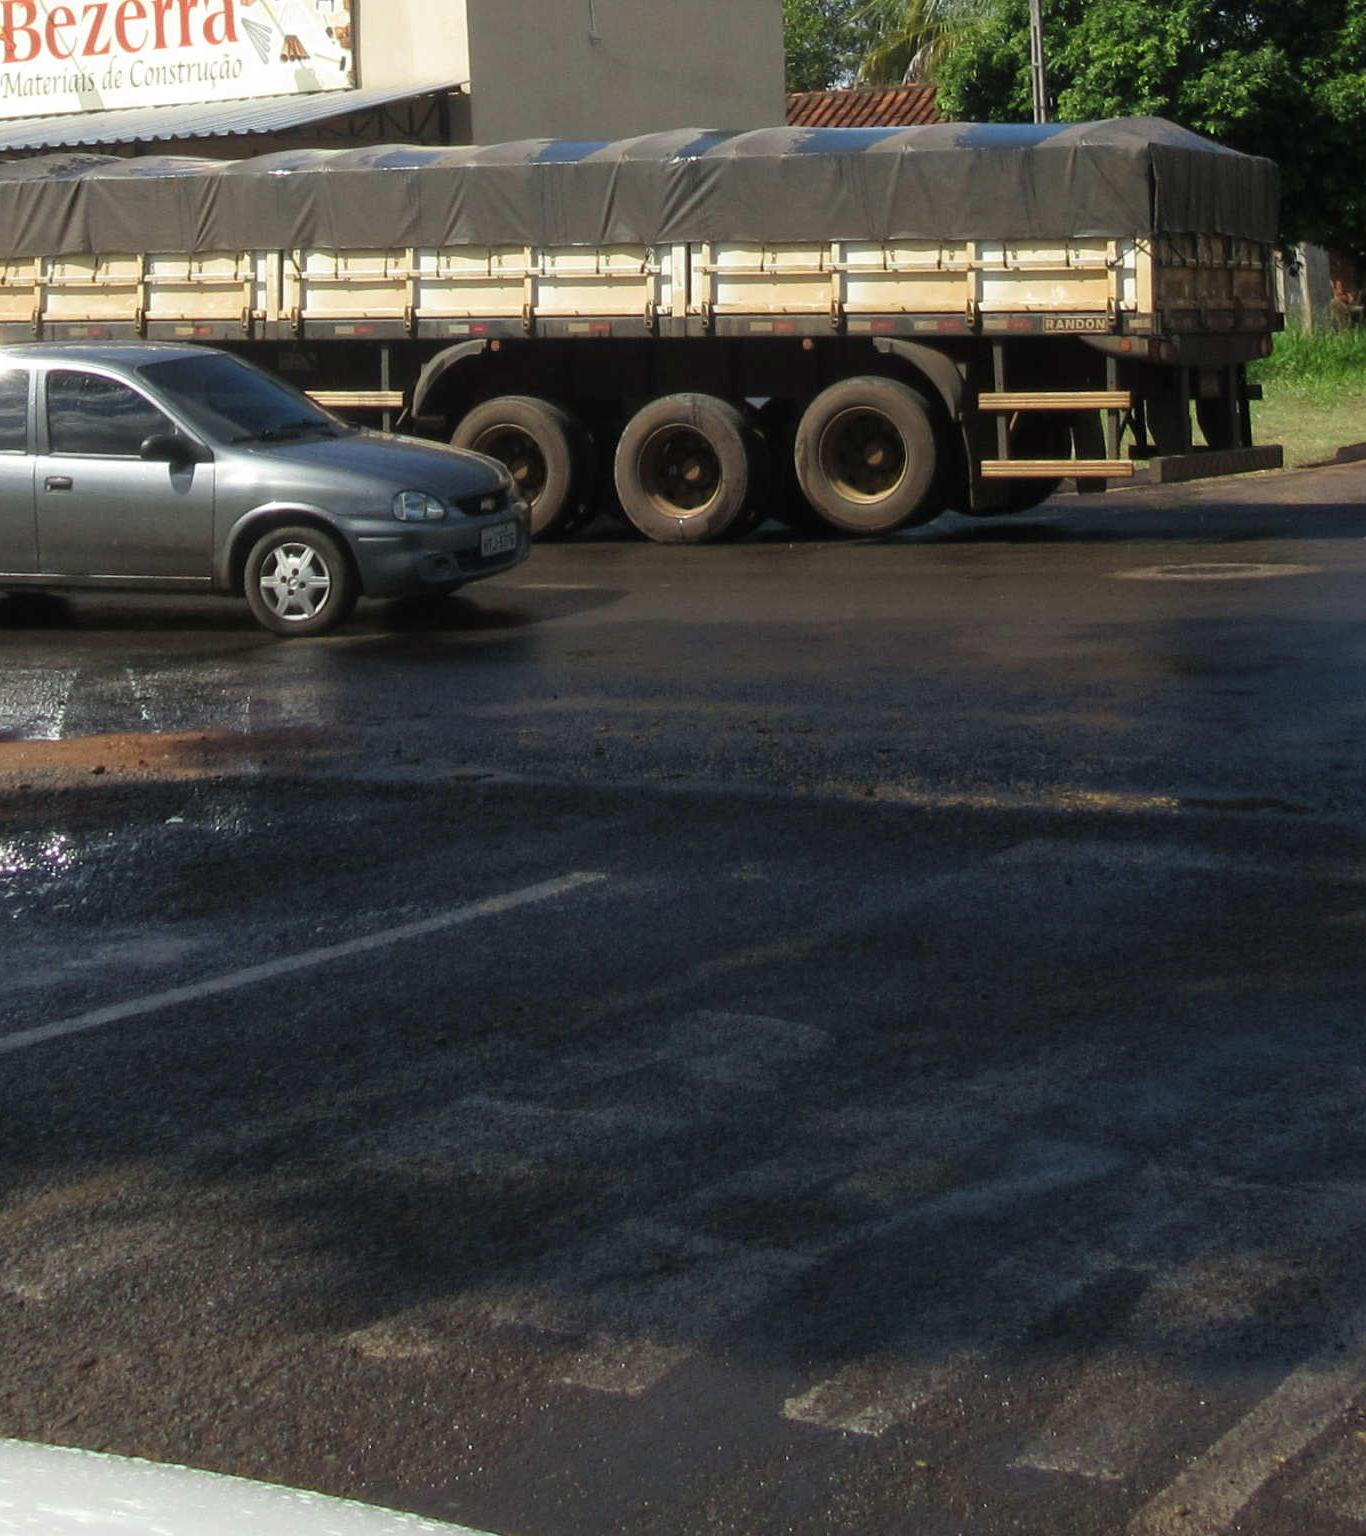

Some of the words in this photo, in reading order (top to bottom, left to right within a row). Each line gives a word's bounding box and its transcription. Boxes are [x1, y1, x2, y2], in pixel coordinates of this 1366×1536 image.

[0, 66, 96, 99] Materiais
[102, 55, 123, 90] de
[130, 54, 243, 89] Construção
[1045, 319, 1106, 330] RANDON
